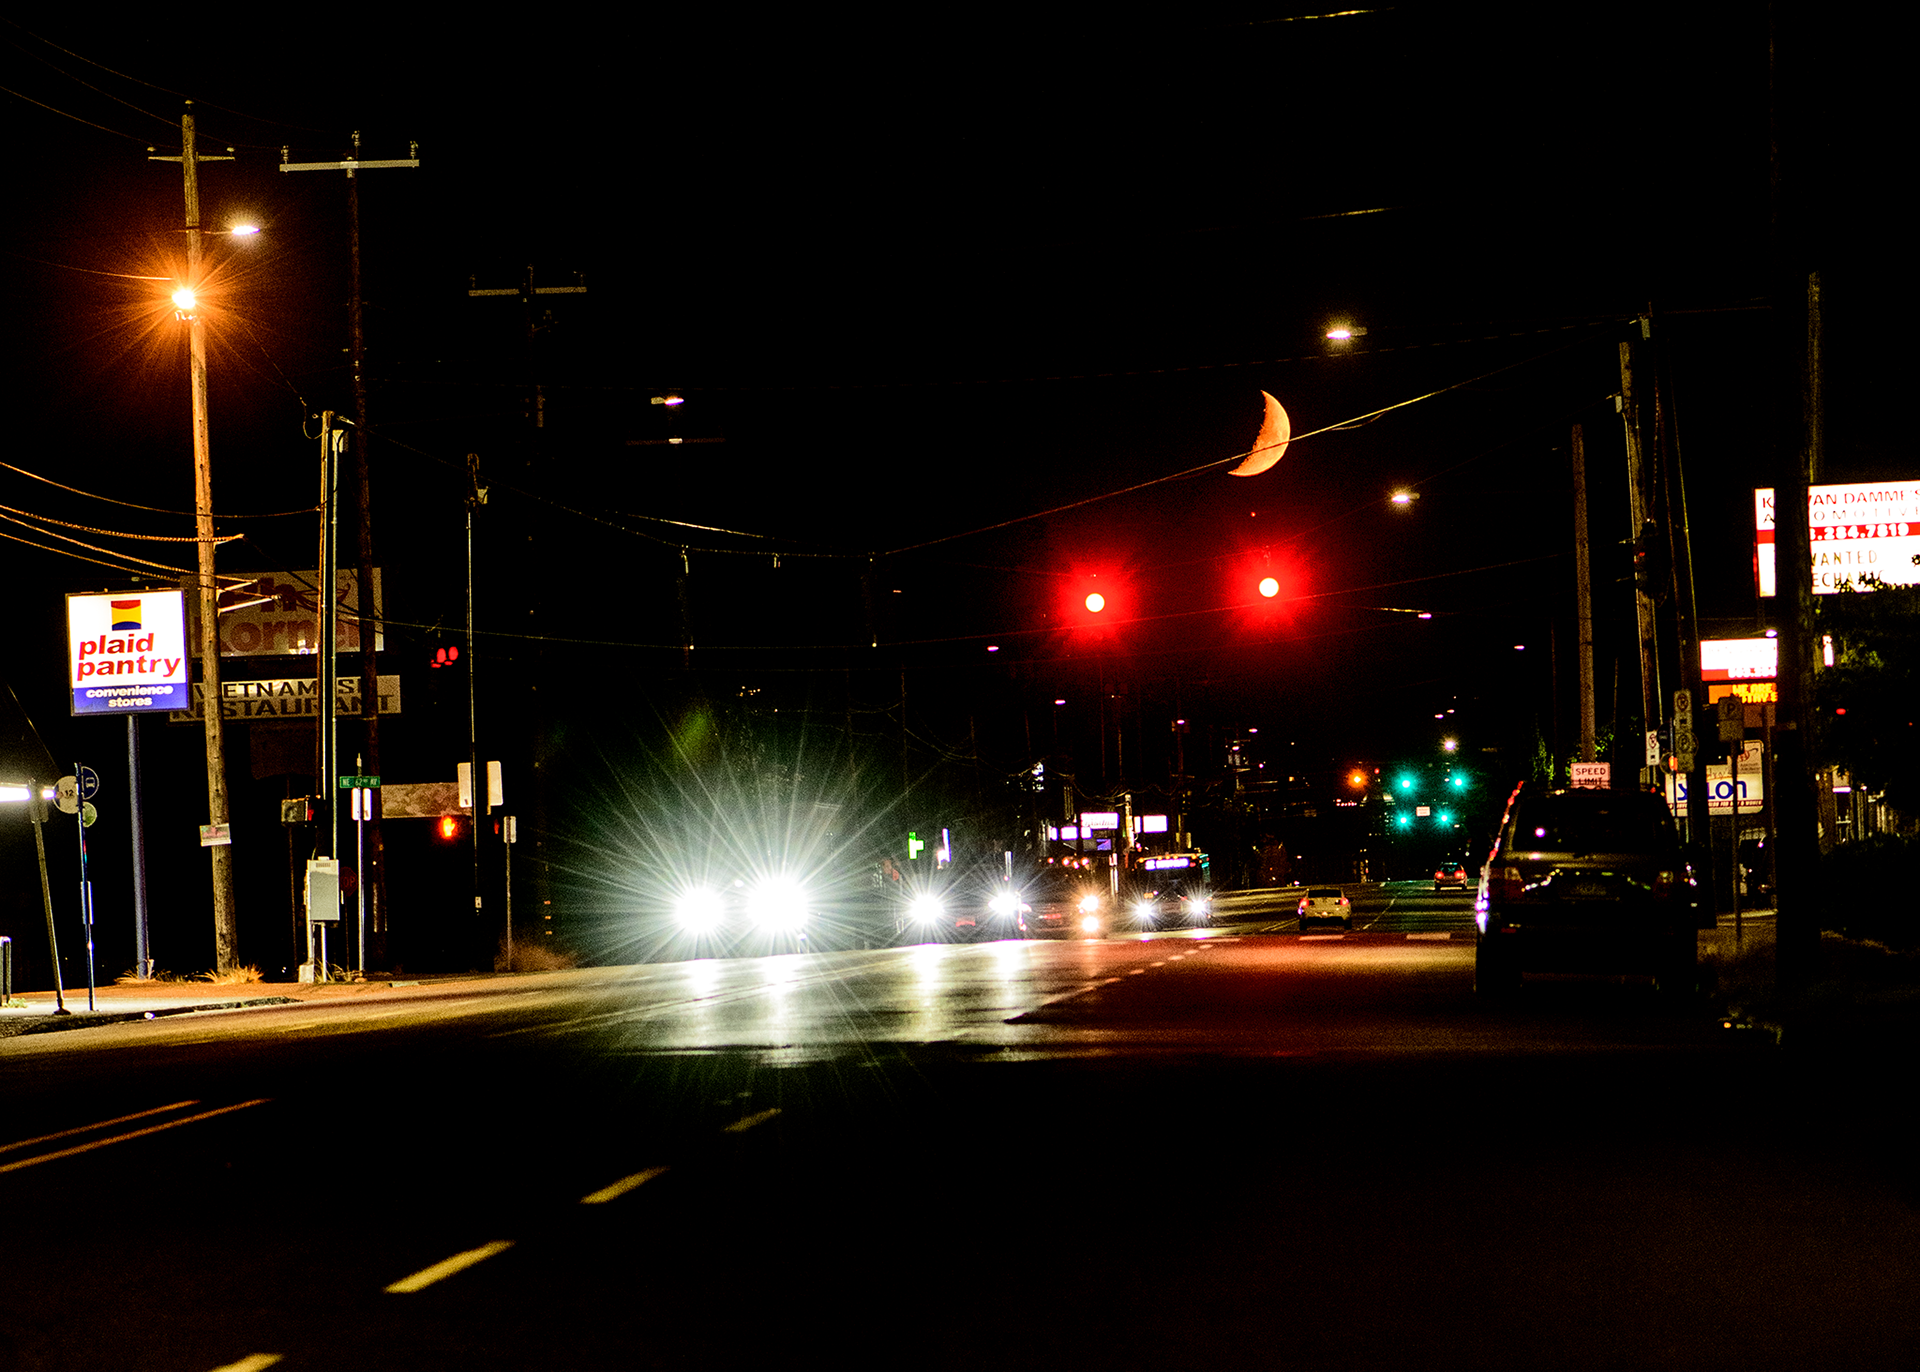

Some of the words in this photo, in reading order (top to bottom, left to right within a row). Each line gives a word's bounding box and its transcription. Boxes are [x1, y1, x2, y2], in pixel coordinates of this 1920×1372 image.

[78, 632, 155, 661] plaid
[76, 655, 182, 682] pantry
[85, 684, 174, 698] convenience
[107, 697, 153, 708] stores
[1575, 767, 1606, 776] SPEED
[1578, 777, 1603, 786] LIMIT
